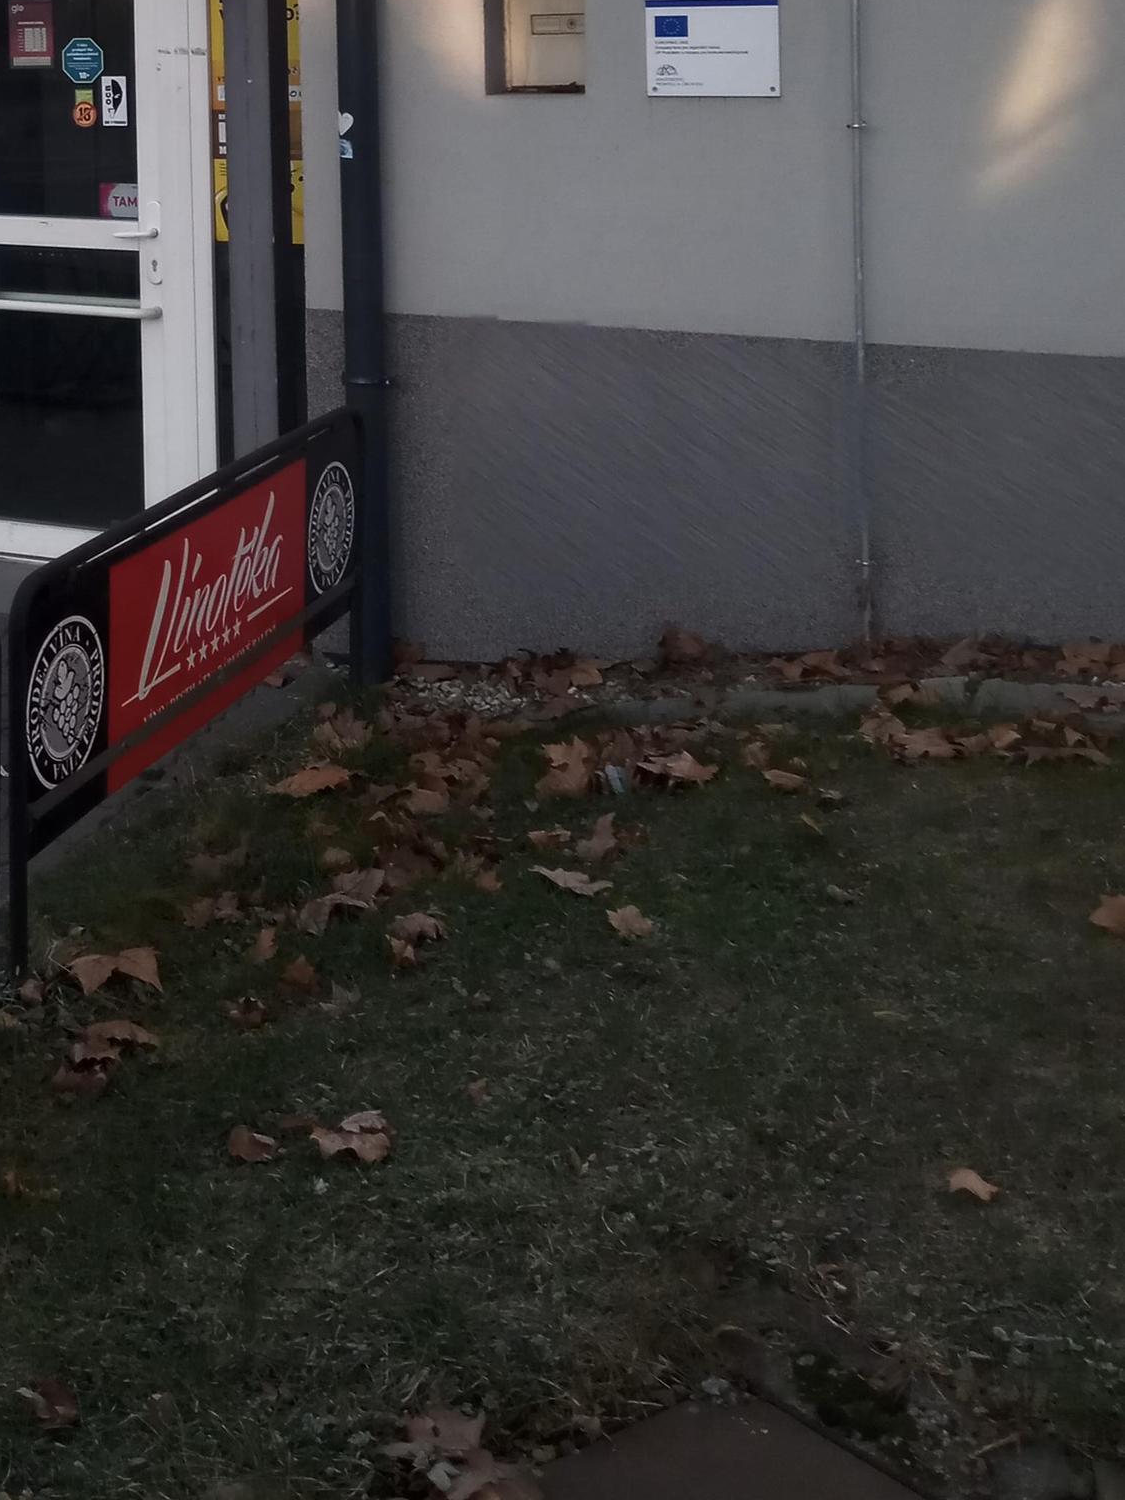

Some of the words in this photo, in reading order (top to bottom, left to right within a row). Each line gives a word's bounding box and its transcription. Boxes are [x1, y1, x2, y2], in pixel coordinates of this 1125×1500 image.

[138, 491, 284, 700] Vinotéka
[29, 656, 50, 758] PRODEJ
[83, 647, 103, 745] PRODEJ
